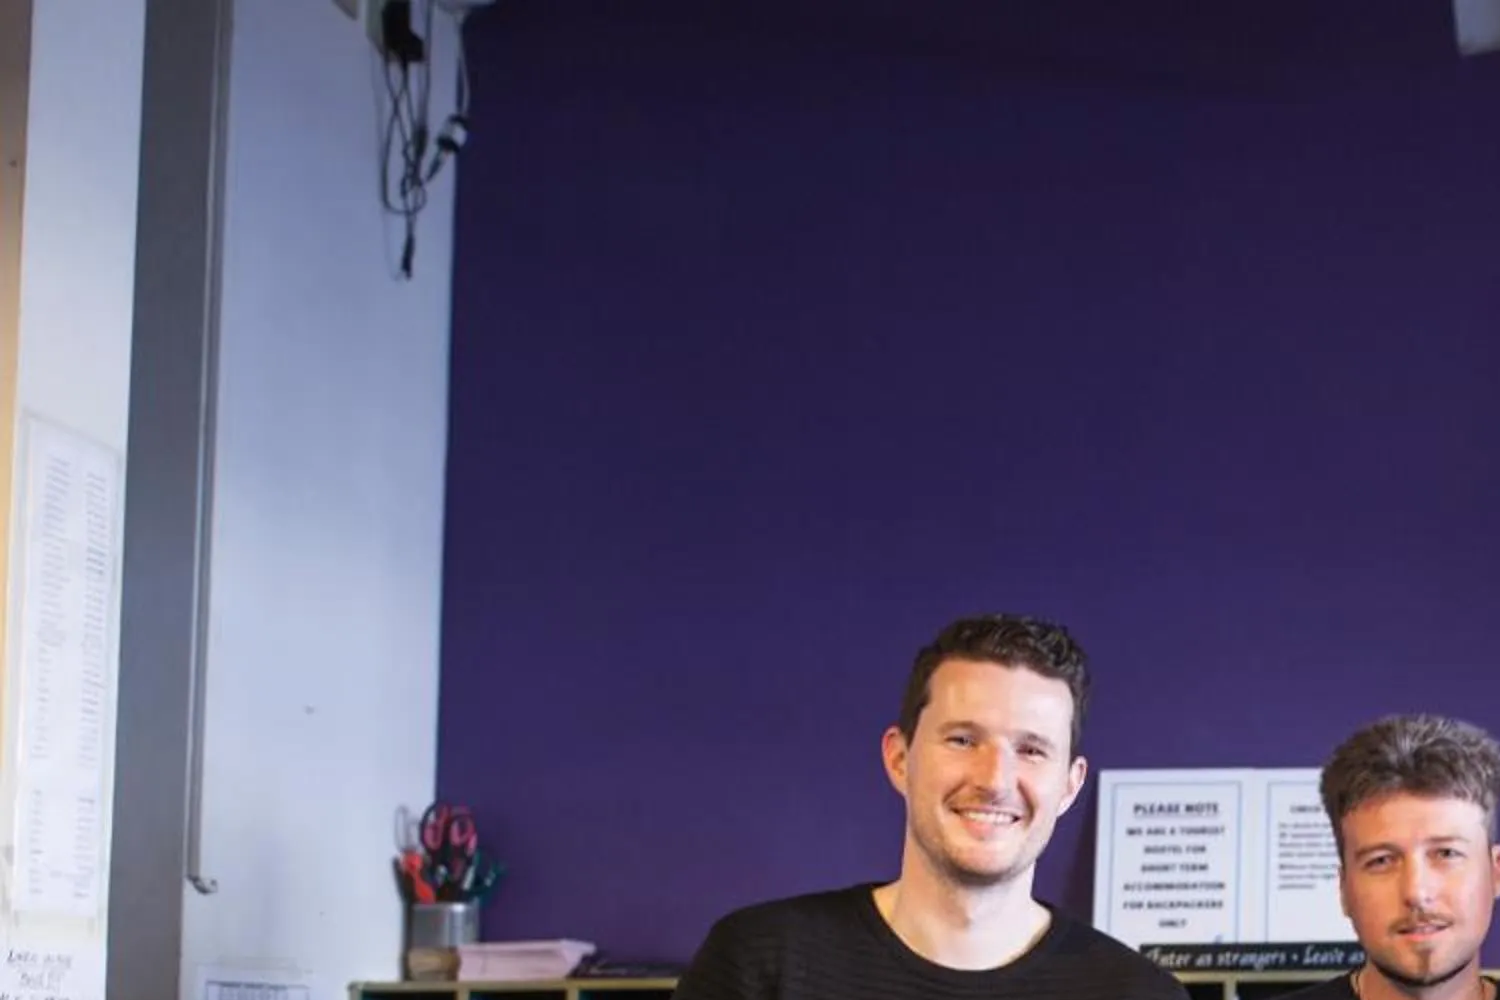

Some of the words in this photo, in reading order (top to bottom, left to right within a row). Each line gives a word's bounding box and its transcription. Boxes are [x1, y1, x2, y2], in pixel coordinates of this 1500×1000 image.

[1133, 803, 1180, 814] PLEASE
[1184, 803, 1218, 813] NOTE
[1126, 826, 1142, 836] WE
[1146, 826, 1166, 835] ARE
[1143, 845, 1183, 854] HOSTEL
[1185, 845, 1207, 854] FOR
[1180, 863, 1209, 872] TERM
[1123, 901, 1143, 909] FOR
[1147, 900, 1223, 910] BACKPACKERS
[1194, 955, 1212, 967] as
[1217, 950, 1287, 971] strangers
[1303, 945, 1344, 965] Leave
